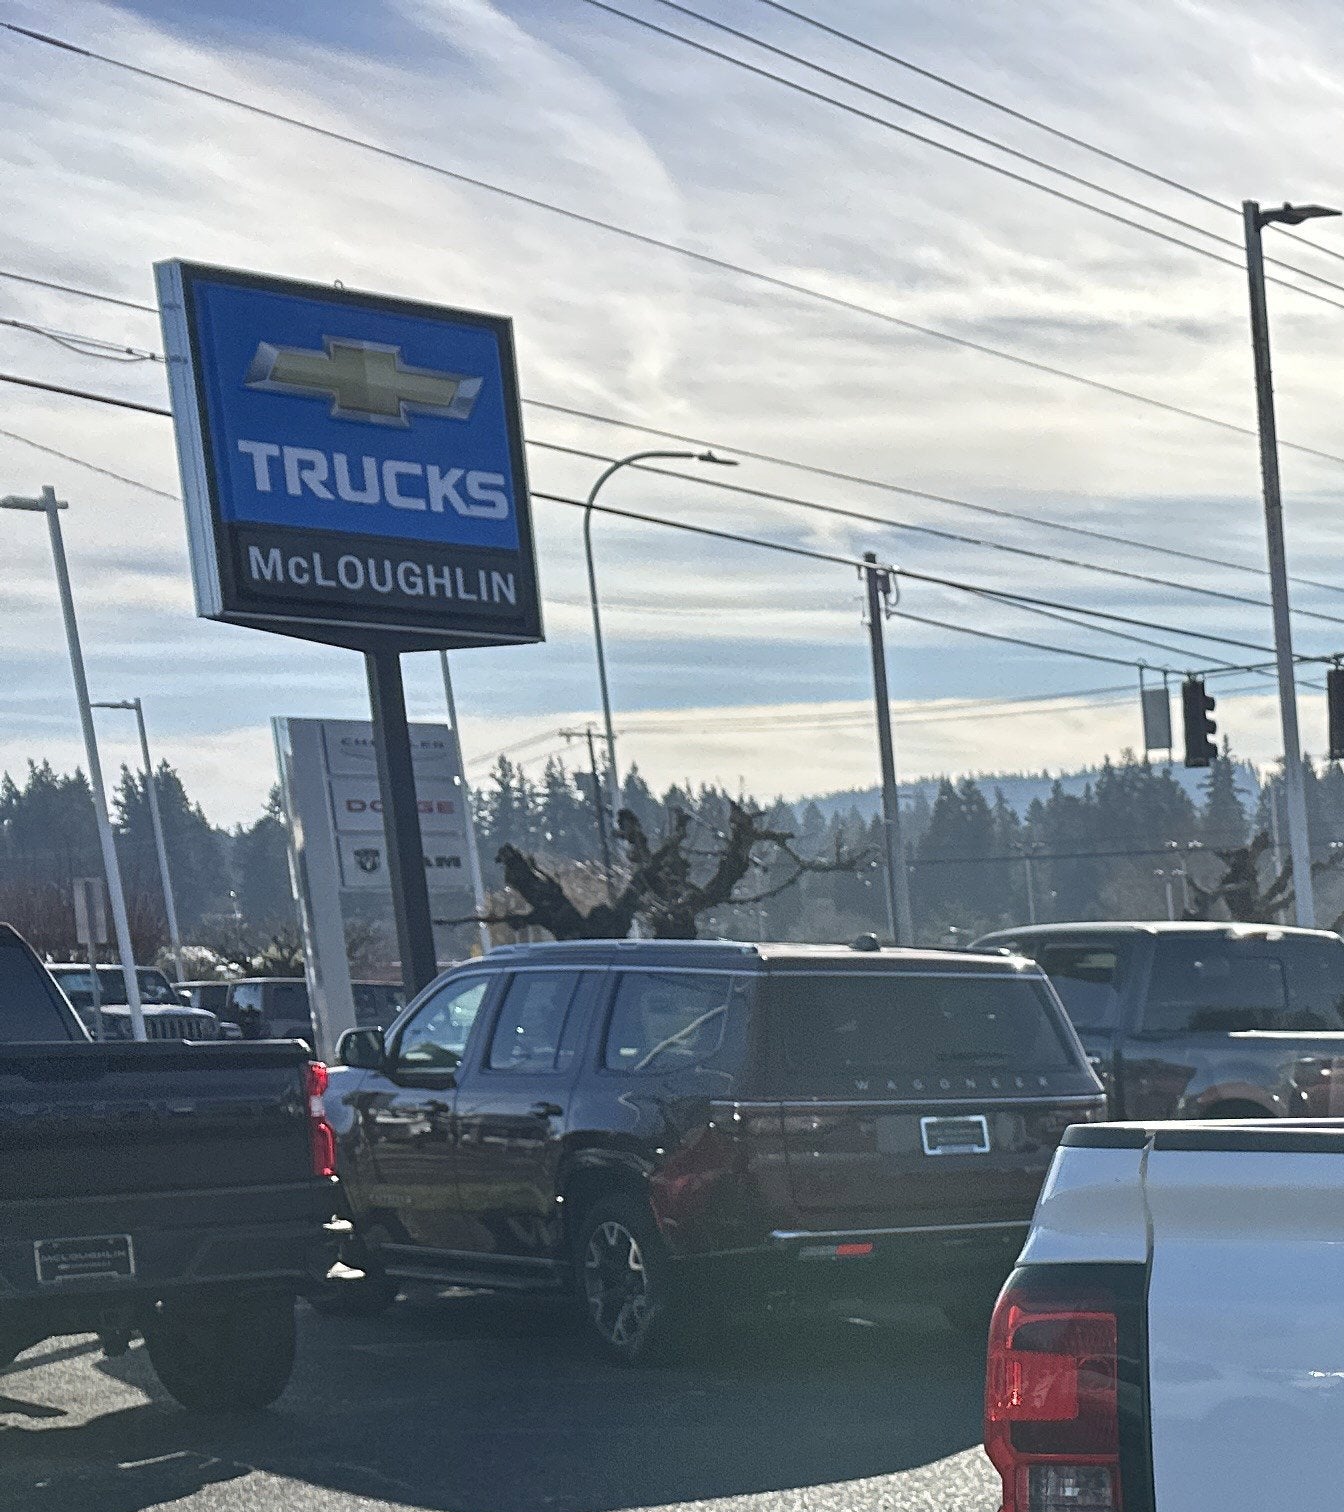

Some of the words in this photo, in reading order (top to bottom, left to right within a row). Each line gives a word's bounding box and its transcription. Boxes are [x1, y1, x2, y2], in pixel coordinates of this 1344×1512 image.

[238, 439, 509, 519] TRUCKS
[249, 545, 516, 604] McLOUGHLIN
[345, 799, 454, 814] DOGE
[855, 1078, 1048, 1091] WAGONEER
